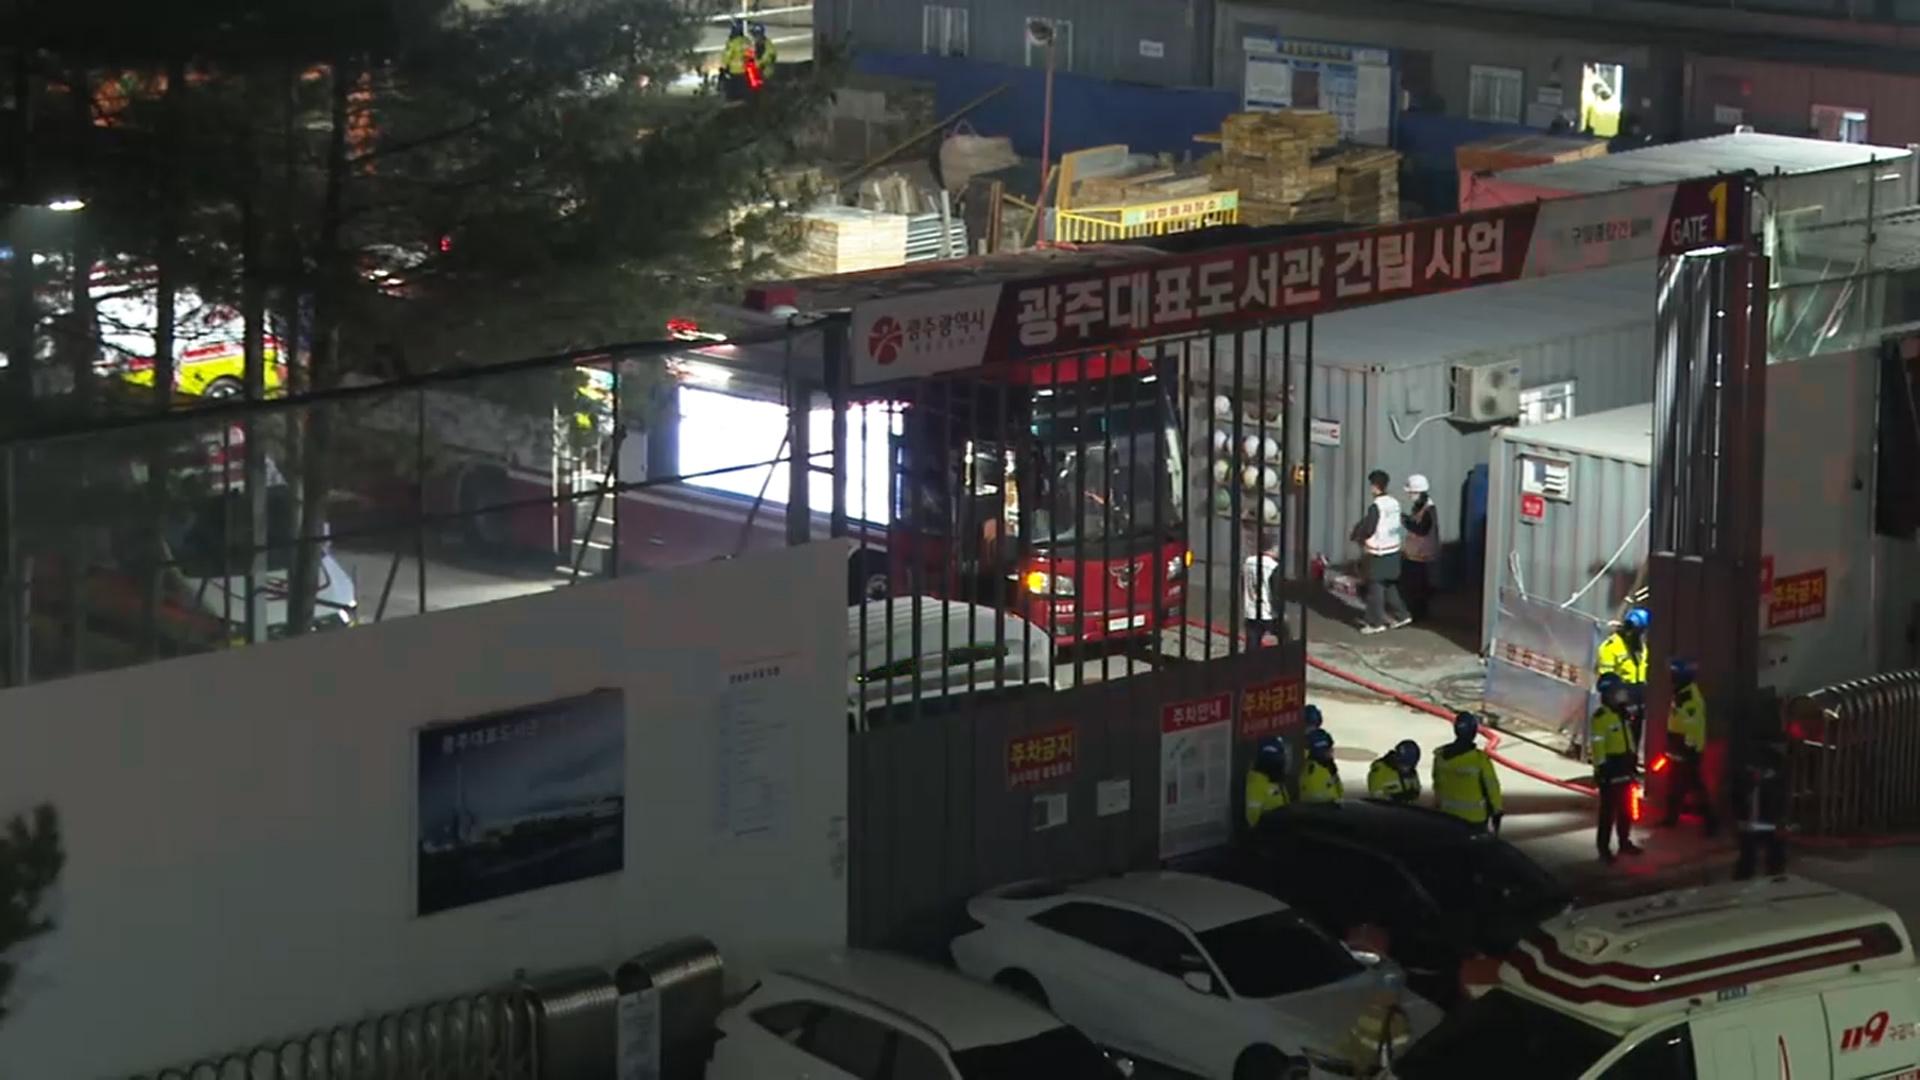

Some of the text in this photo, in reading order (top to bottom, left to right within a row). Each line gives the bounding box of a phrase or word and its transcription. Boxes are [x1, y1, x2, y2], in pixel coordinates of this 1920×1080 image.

[1670, 182, 1728, 246] GATE 1
[1015, 219, 1505, 345] 광주대표도서관 건립 사업
[906, 308, 984, 342] 광주광역시
[1172, 697, 1221, 725] 주차안내
[1242, 685, 1298, 719] 주차금지
[1010, 730, 1072, 769] 주차금지
[1840, 1010, 1890, 1051] 119
